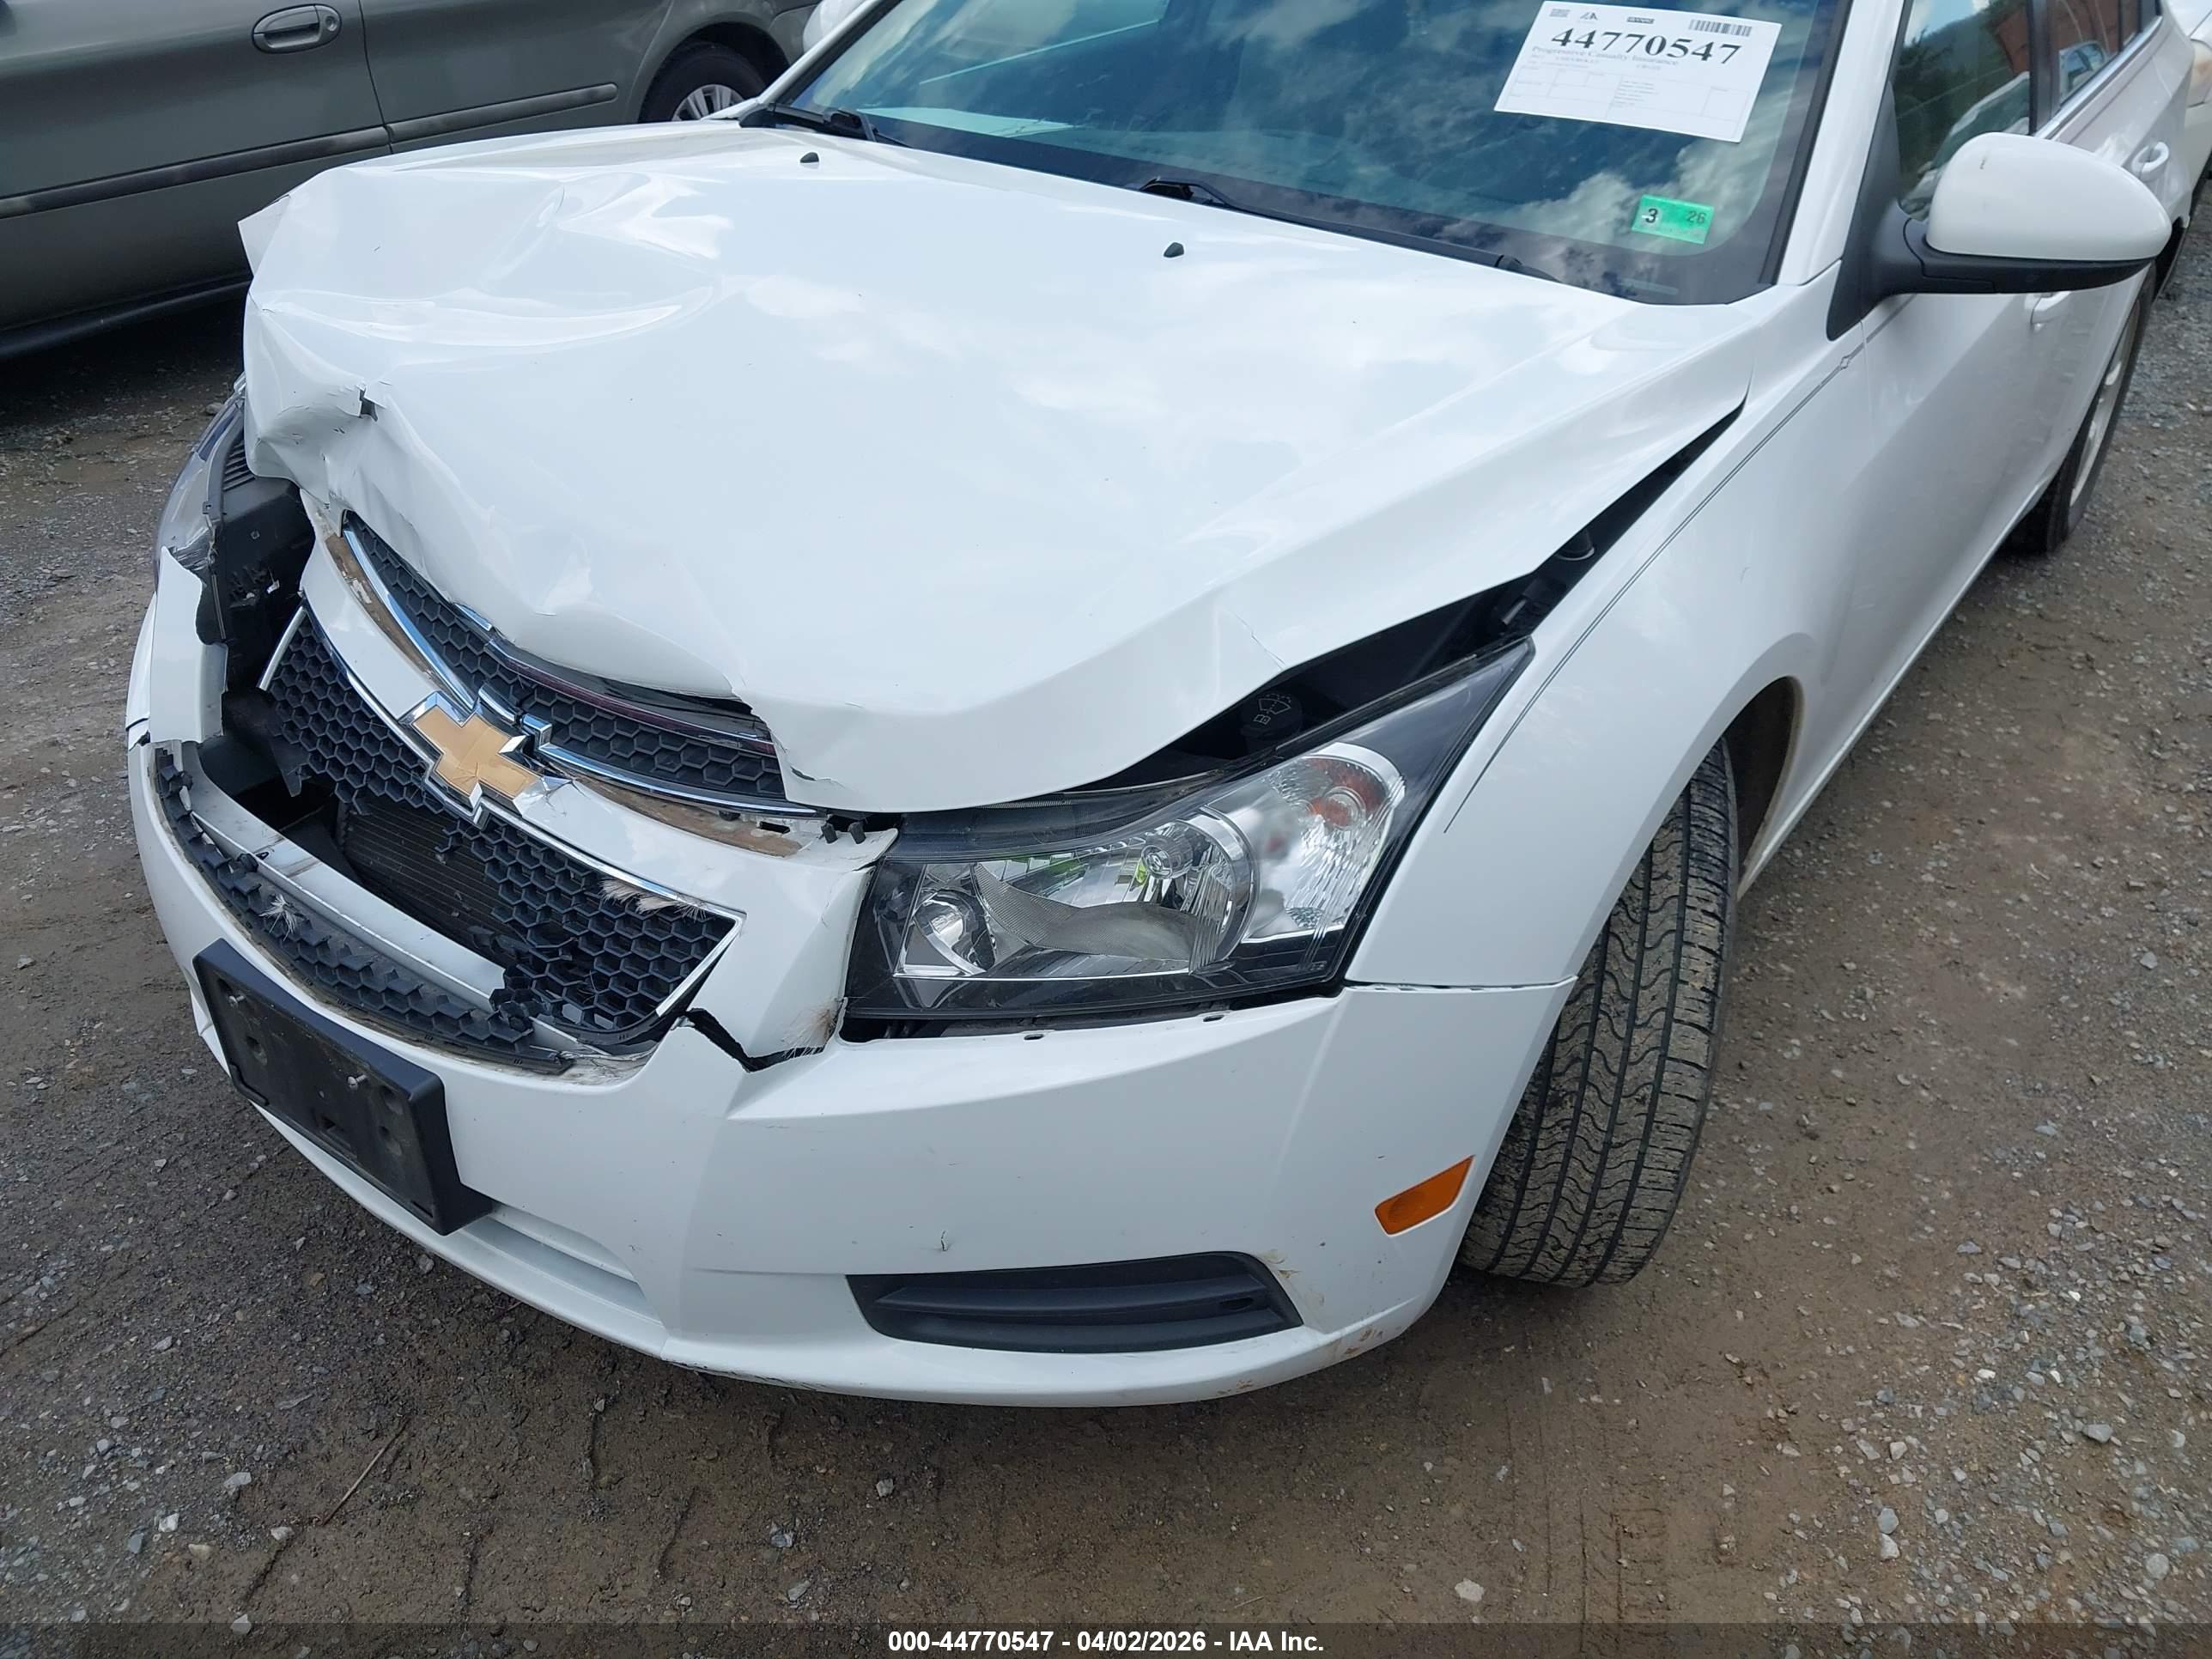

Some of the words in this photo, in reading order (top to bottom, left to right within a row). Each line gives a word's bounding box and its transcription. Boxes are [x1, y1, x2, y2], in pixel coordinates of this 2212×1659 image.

[1551, 27, 1741, 64] 44770547
[1644, 208, 1659, 224] 3
[1686, 210, 1707, 225] 26
